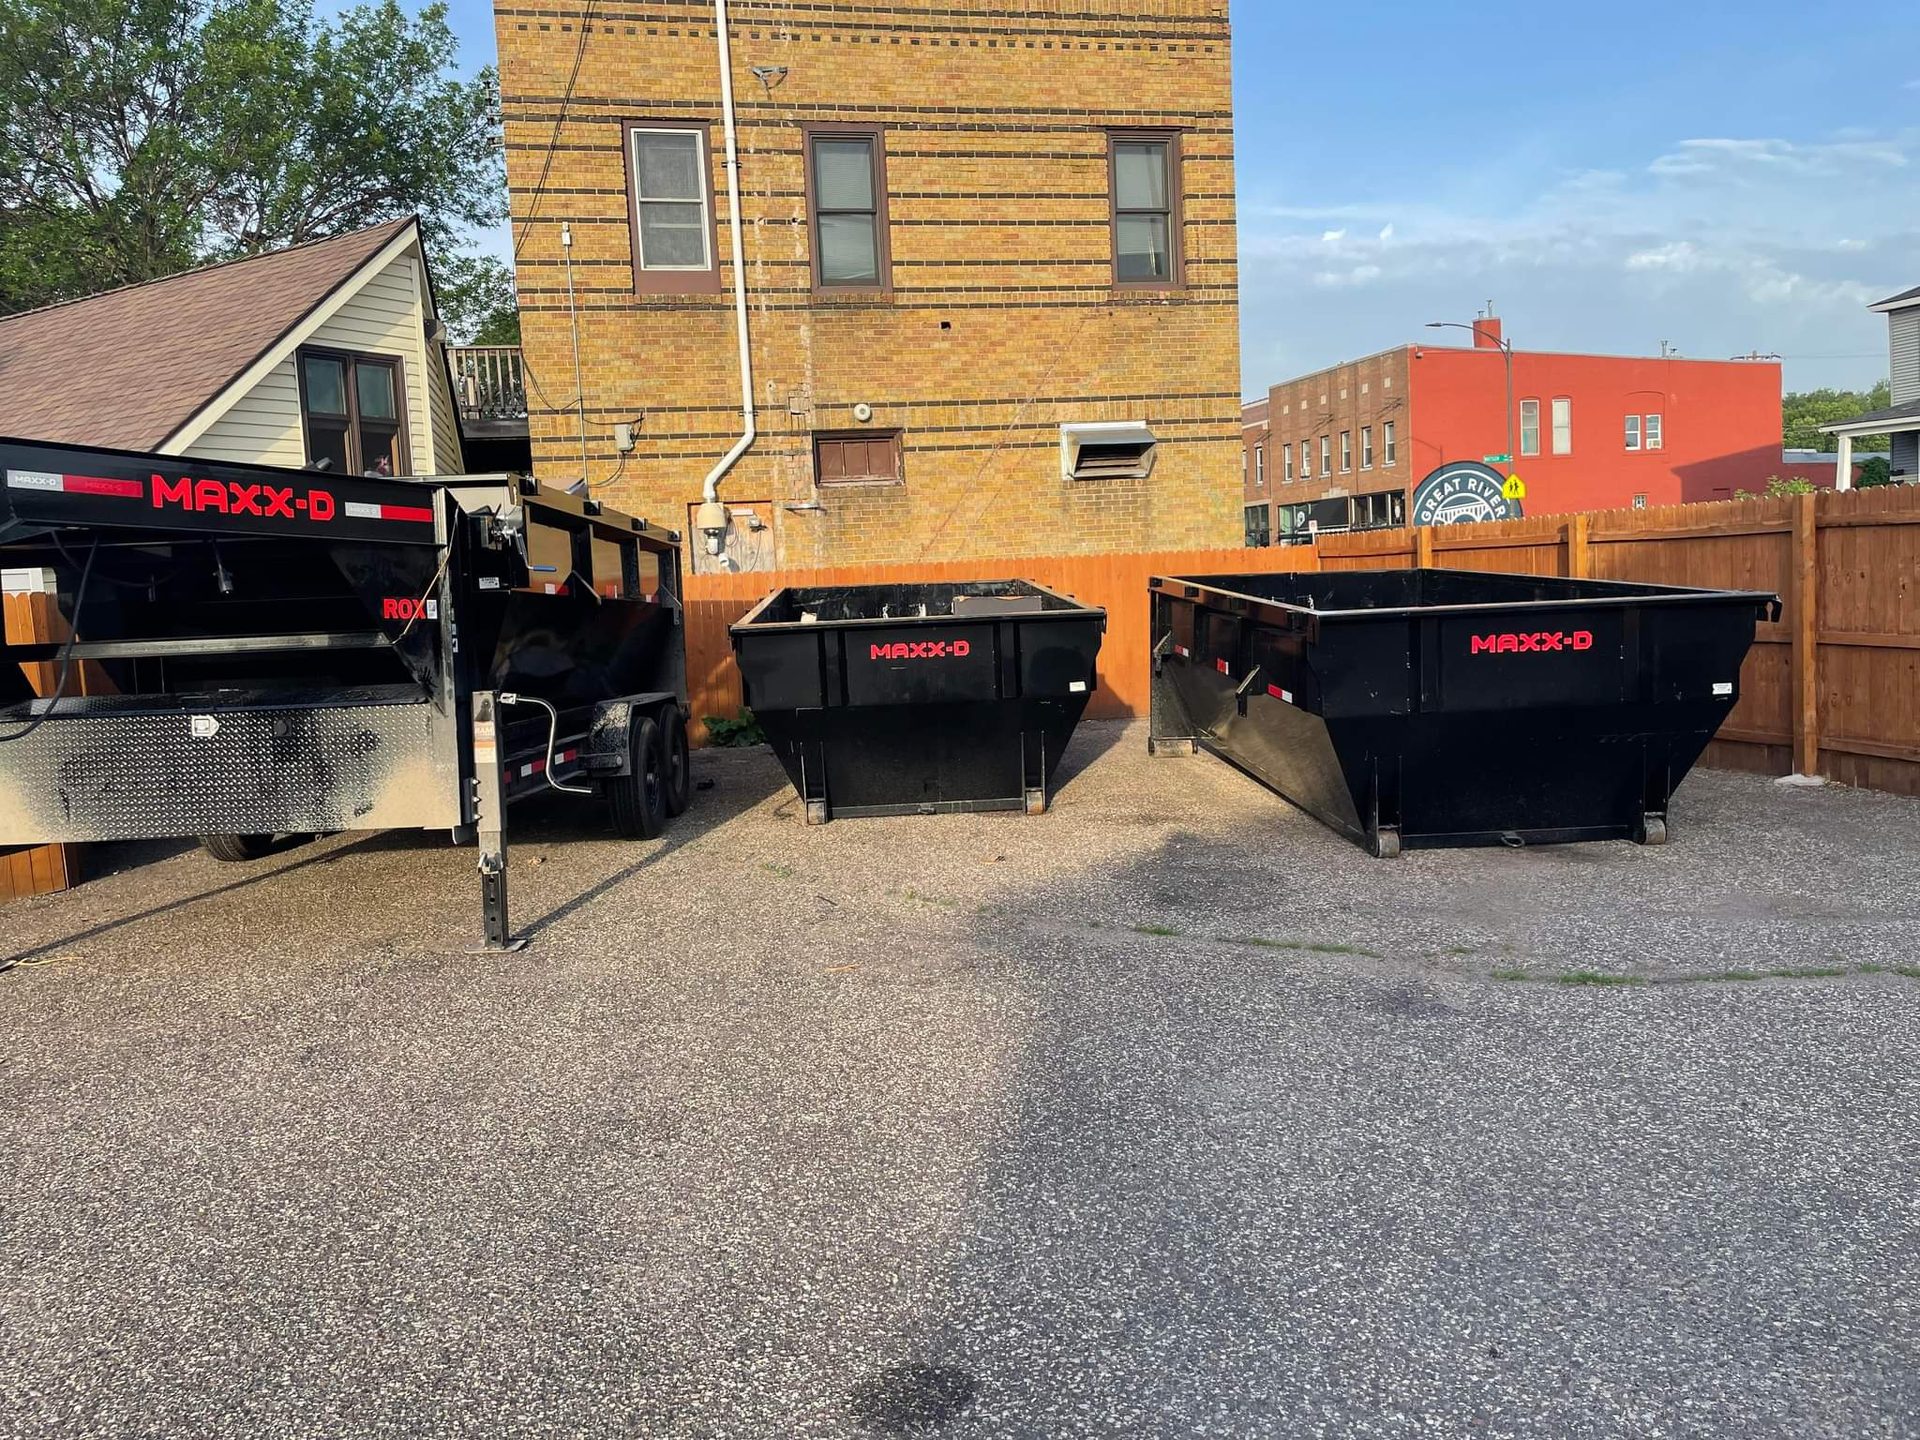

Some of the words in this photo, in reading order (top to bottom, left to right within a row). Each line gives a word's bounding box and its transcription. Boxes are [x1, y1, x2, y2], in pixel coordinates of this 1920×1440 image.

[15, 475, 56, 486] MAXX-D
[151, 474, 335, 521] MAXX-D
[1421, 478, 1461, 522] GREAT
[1468, 478, 1506, 516] RIVER
[384, 599, 426, 619] ROX
[870, 640, 970, 660] MAXX-D
[1471, 631, 1593, 654] MAXX-D
